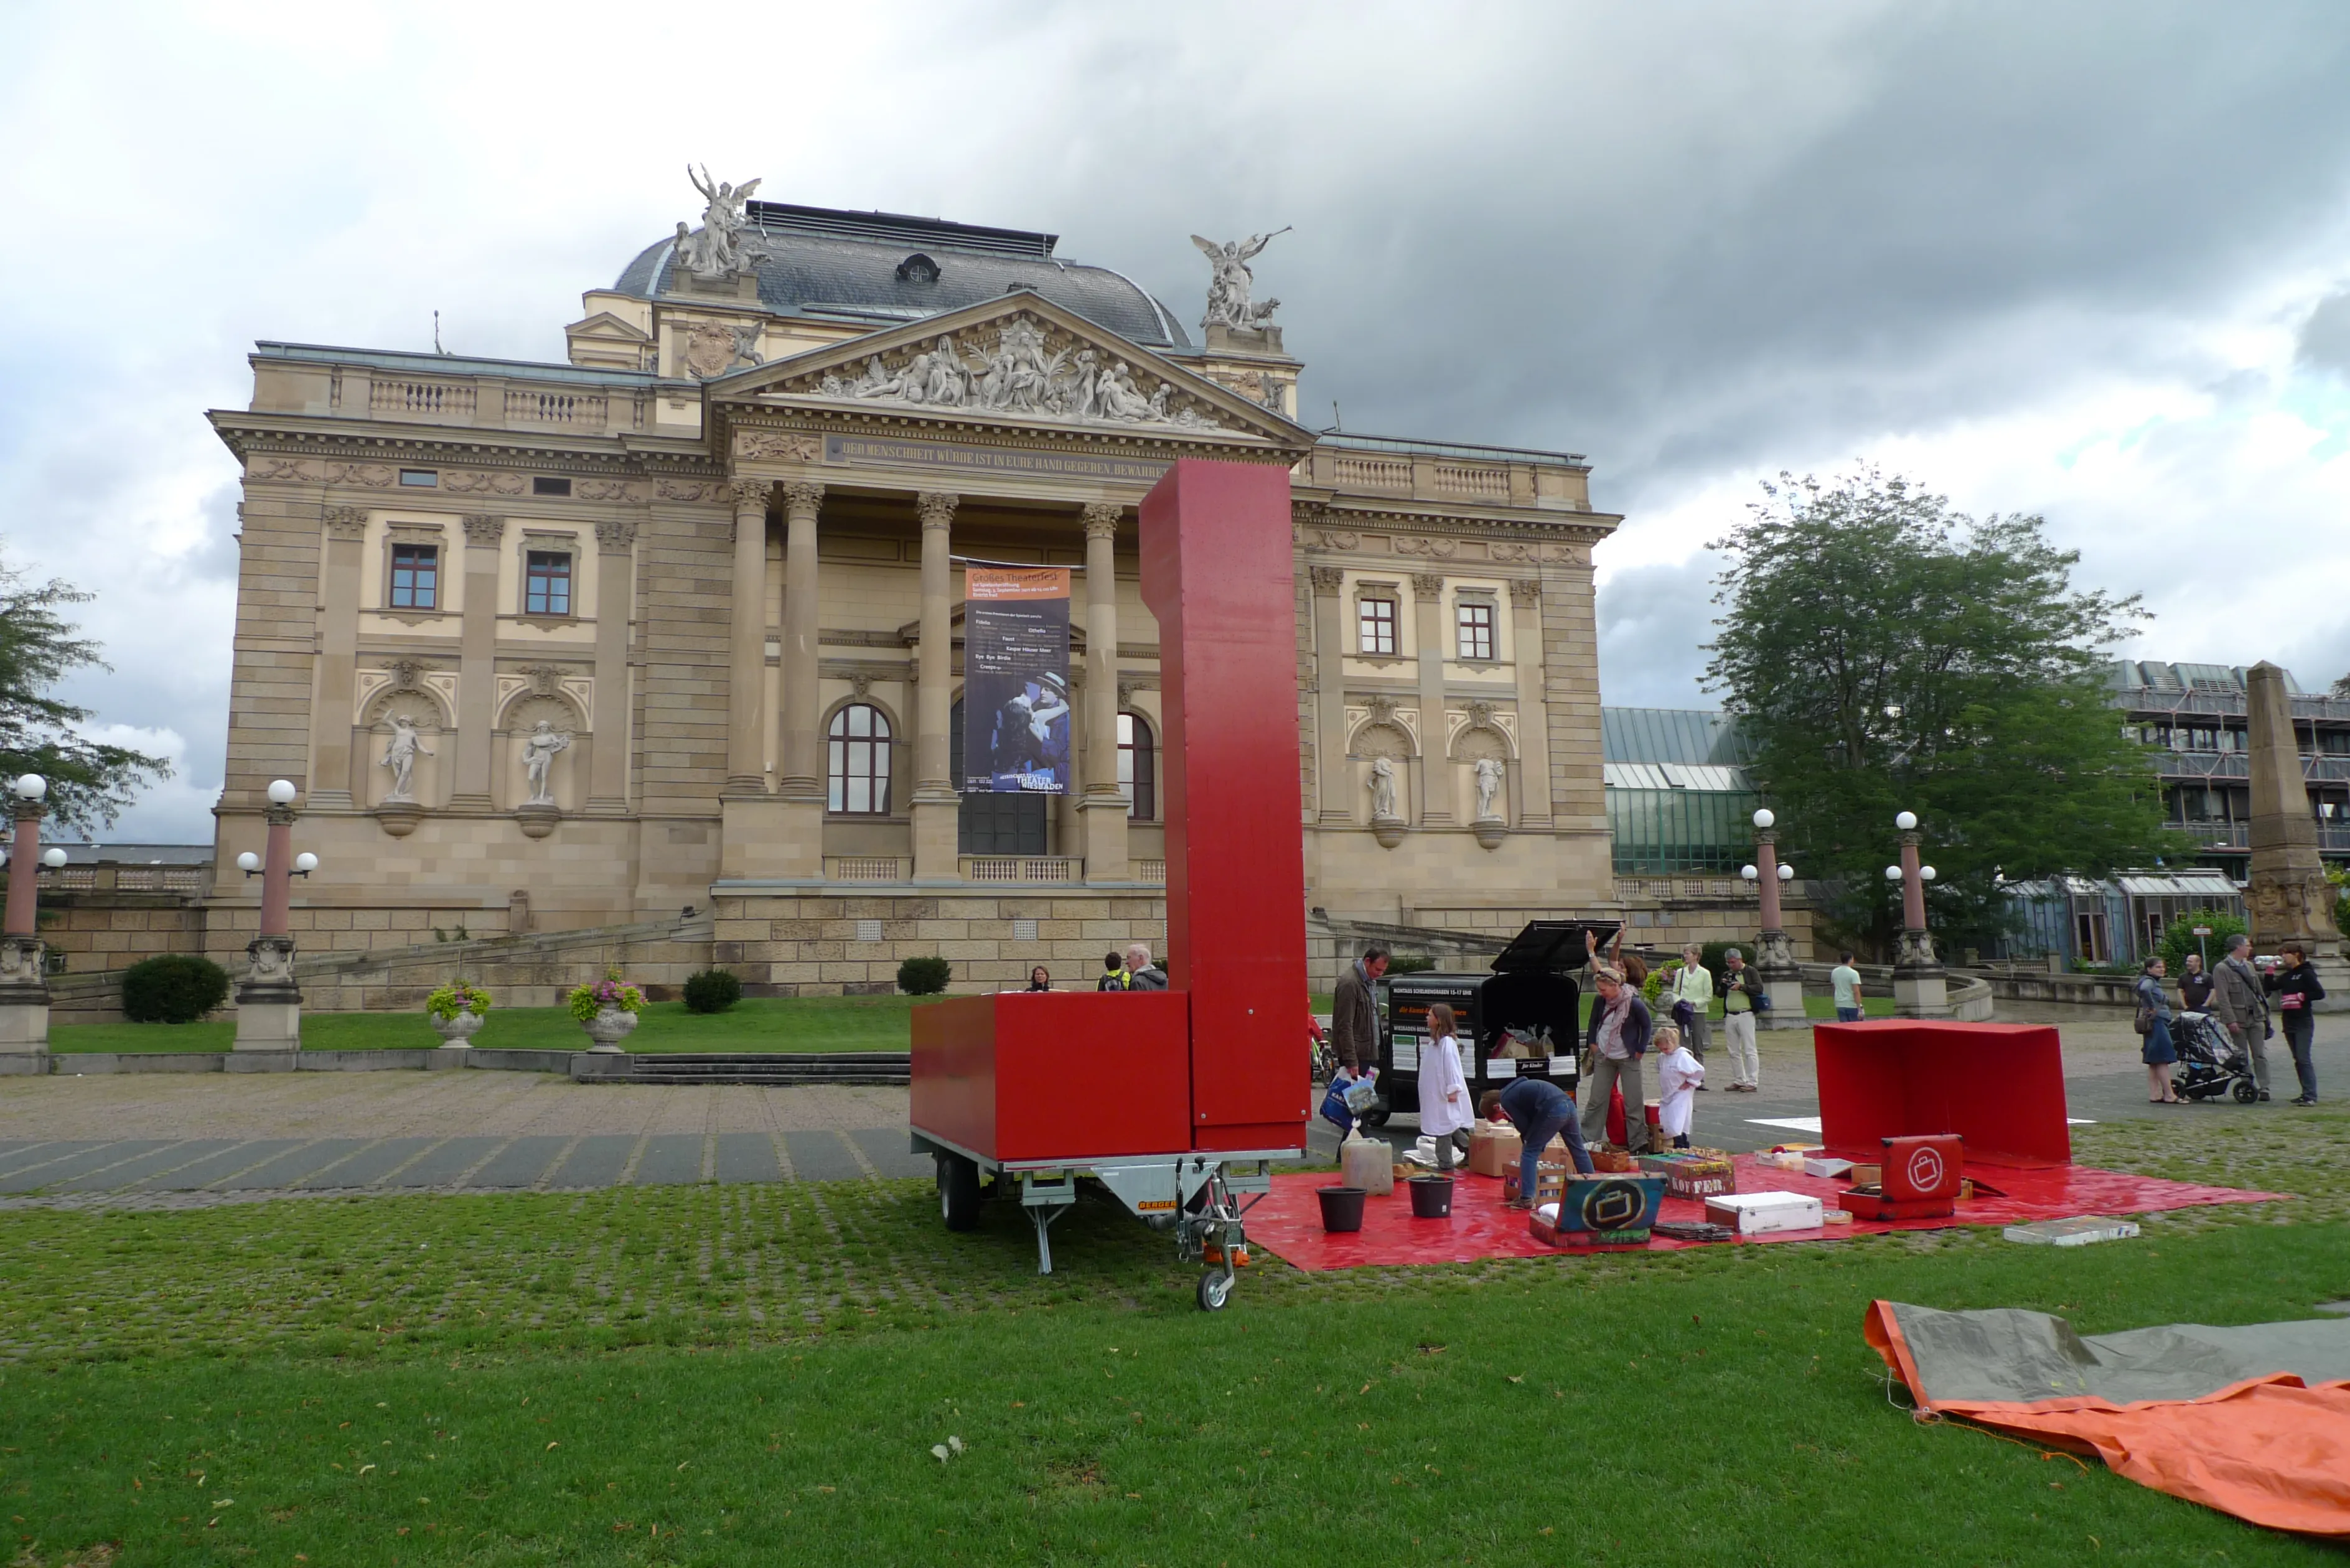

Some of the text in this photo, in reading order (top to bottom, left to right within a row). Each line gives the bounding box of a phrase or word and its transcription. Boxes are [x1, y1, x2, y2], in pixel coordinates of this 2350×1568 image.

[843, 442, 864, 455] DER
[867, 444, 934, 461] MENSCHHEIT
[937, 449, 973, 464] WÜRDE
[975, 454, 992, 465] IST
[994, 455, 1004, 466] IN
[1006, 455, 1033, 468] EURE
[1036, 458, 1062, 471] HAND
[1064, 460, 1113, 475] GEGEBEN,
[972, 572, 1058, 582] Großes Theaterfest
[1021, 782, 1063, 790] WIESBADEN
[1139, 1200, 1177, 1209] BERGER
